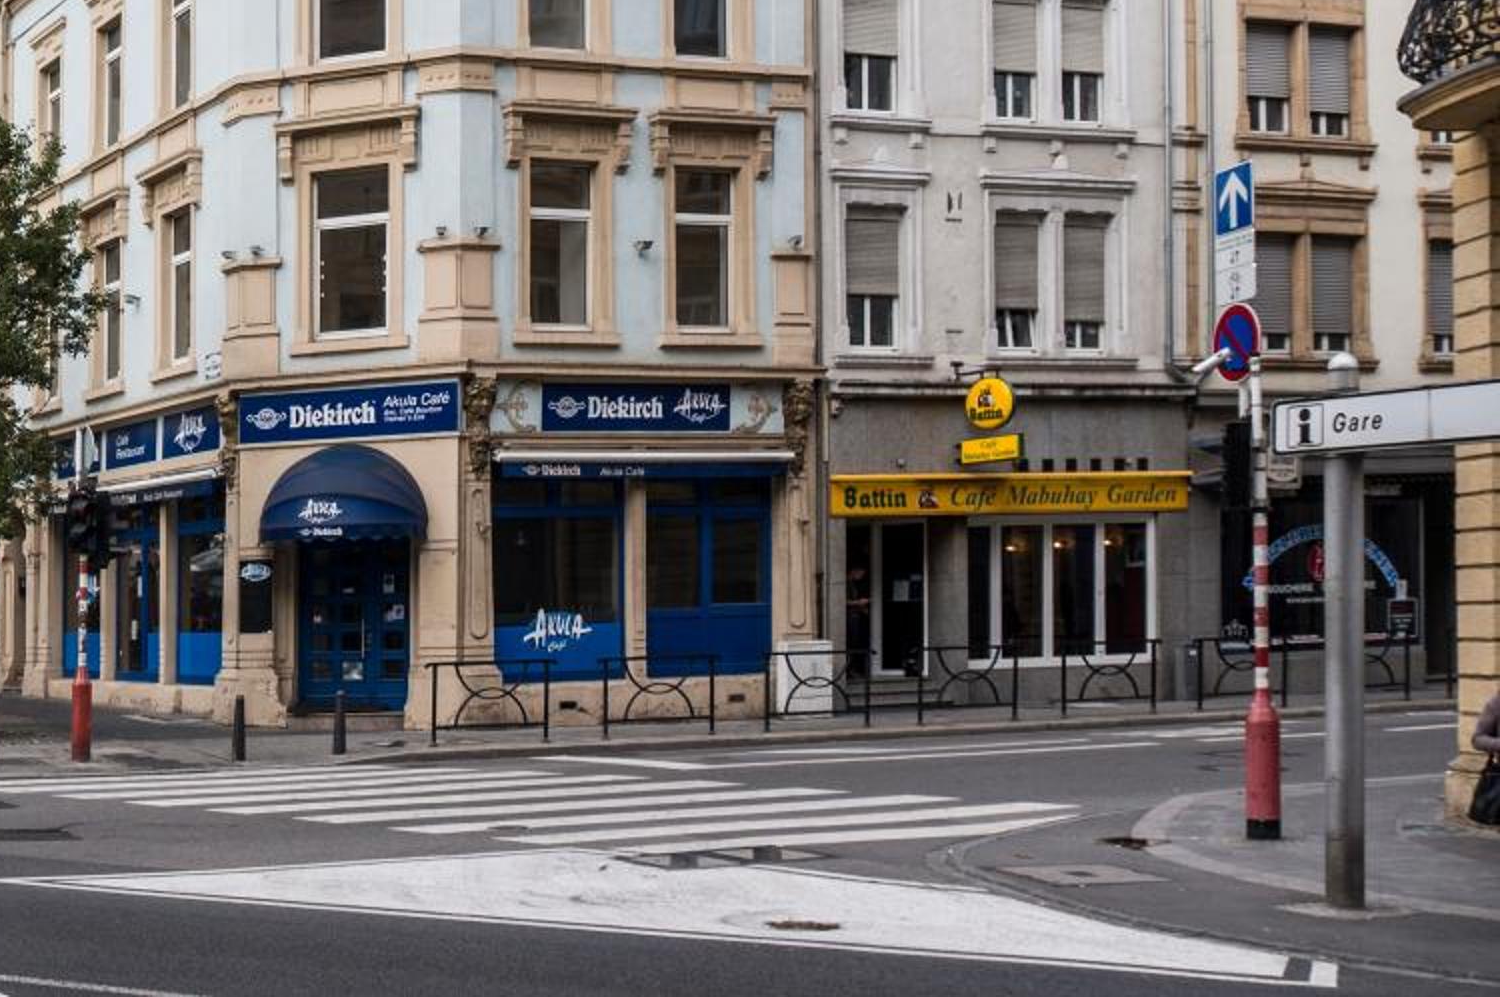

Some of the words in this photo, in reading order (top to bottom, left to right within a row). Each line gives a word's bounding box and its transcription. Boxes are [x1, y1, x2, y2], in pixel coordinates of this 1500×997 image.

[383, 394, 418, 408] Akula
[421, 389, 451, 406] Café
[587, 396, 664, 419] Diekirch
[289, 400, 376, 428] Diekirch
[1332, 411, 1384, 434] Gare
[541, 463, 581, 476] Diekirch
[843, 485, 907, 509] Battin
[951, 484, 997, 511] Café
[1008, 484, 1098, 511] Mabuhay
[1107, 481, 1177, 505] Garden
[523, 608, 593, 650] AKULA
